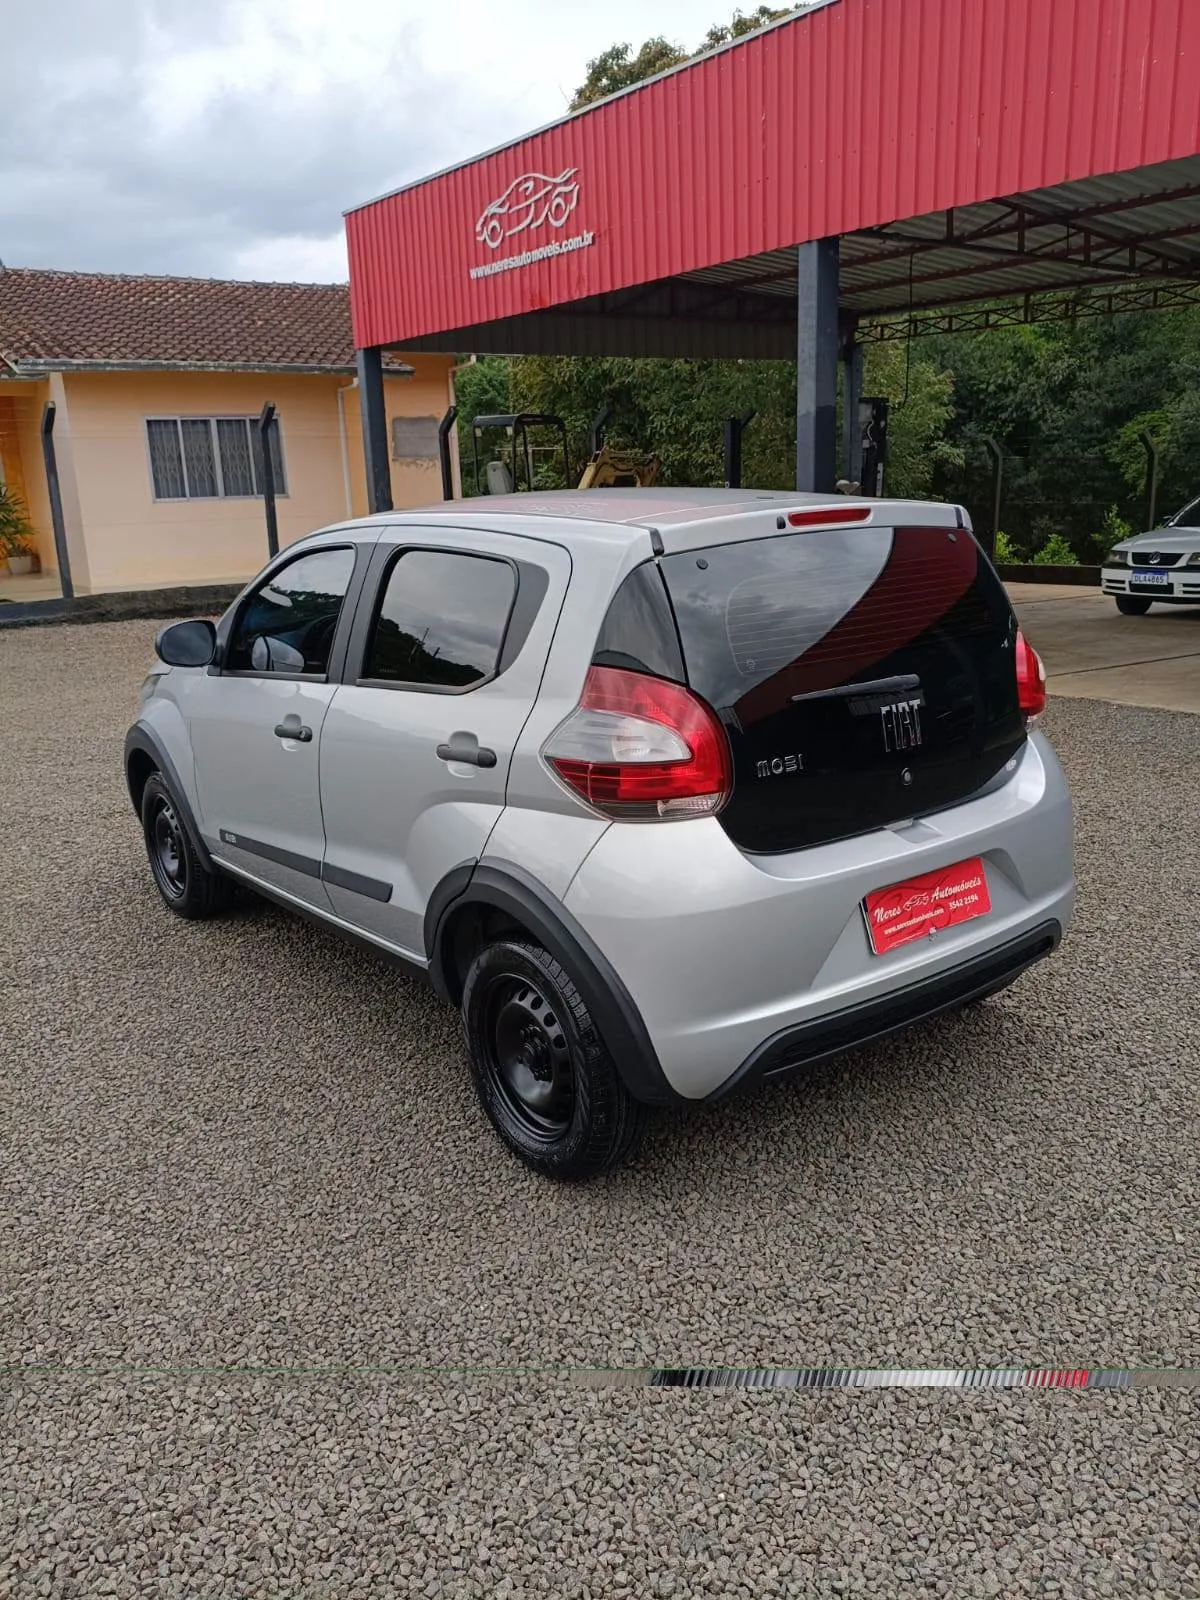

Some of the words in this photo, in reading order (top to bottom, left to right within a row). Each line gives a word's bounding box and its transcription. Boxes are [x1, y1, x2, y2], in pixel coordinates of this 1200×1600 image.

[469, 229, 594, 279] www.neresautomoveis.com.br
[880, 699, 922, 752] FIAT
[757, 753, 804, 778] MOBI
[874, 906, 902, 923] Neres
[931, 876, 981, 903] Automóveis
